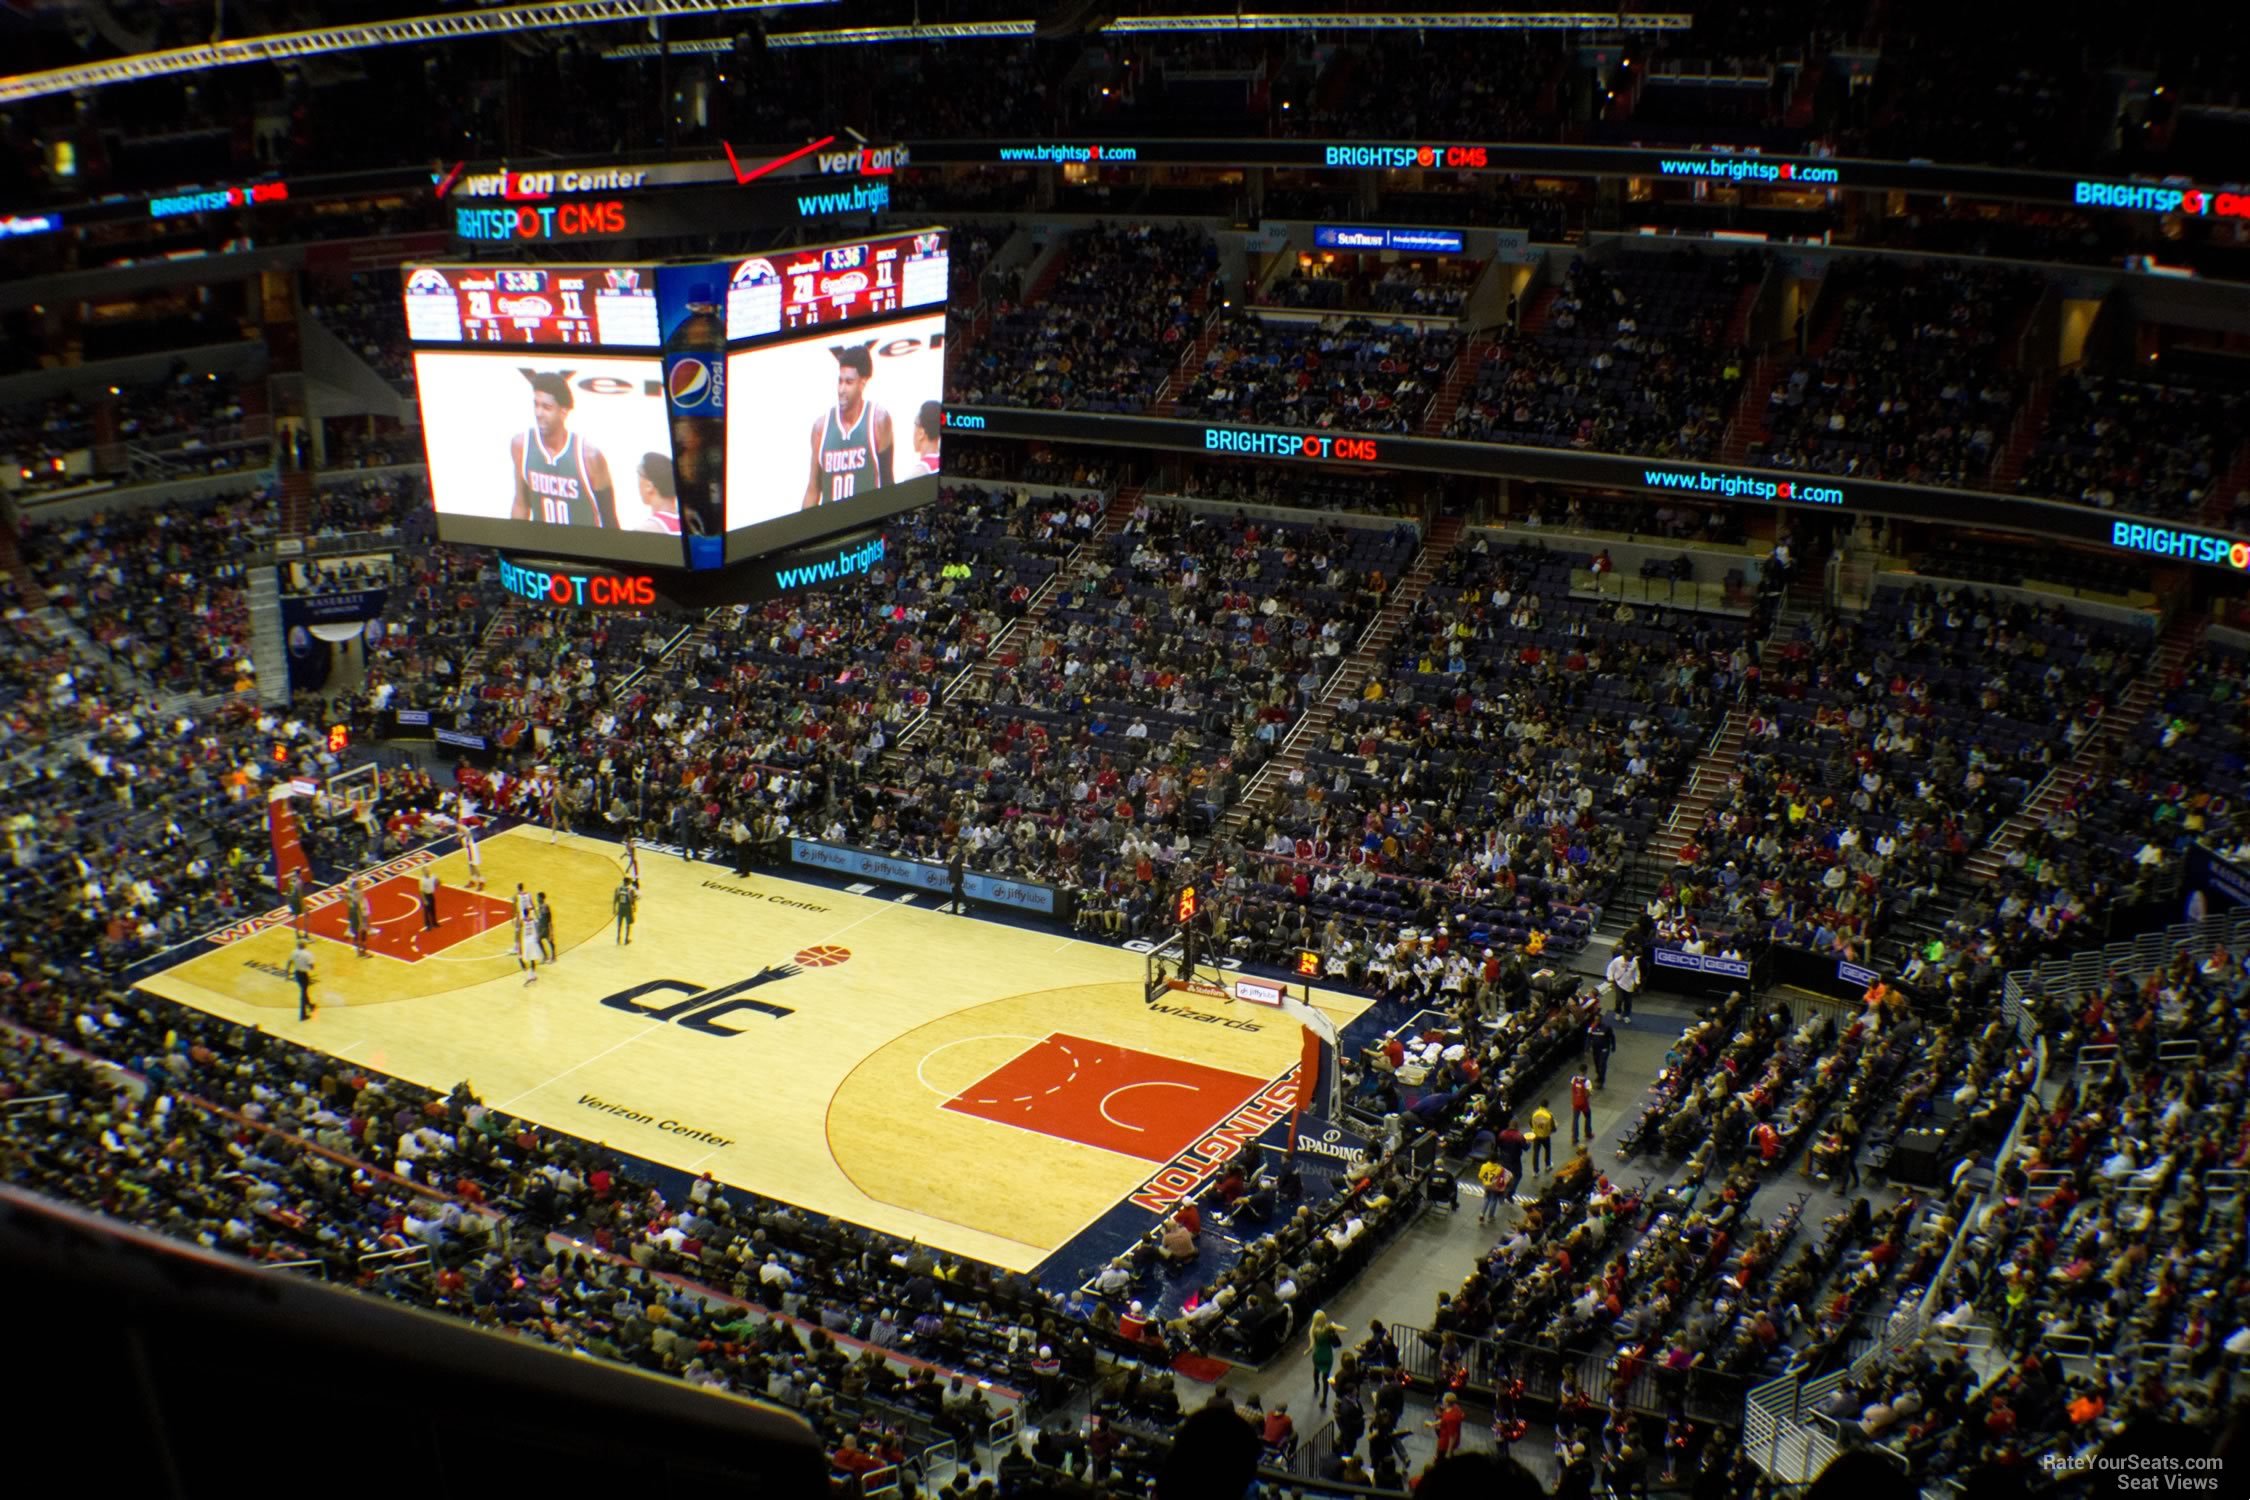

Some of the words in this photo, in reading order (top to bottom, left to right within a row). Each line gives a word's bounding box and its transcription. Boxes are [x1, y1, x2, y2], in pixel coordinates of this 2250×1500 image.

[818, 144, 894, 175] verizon
[1000, 145, 1137, 163] www.brightspot.com
[1326, 146, 1444, 168] BRIGHTSPOT
[1446, 146, 1488, 168] CMS
[467, 168, 554, 200] verizon
[561, 171, 646, 192] Center
[1661, 158, 1839, 184] www.brightspot.com
[151, 187, 254, 217] BRIGHTSPOT
[2075, 181, 2213, 216] BRIGHTSPOT
[558, 201, 626, 235] CMS
[830, 248, 860, 269] 3:36
[825, 446, 866, 473] BUCKS
[1206, 429, 1332, 458] BRIGHTSPOT
[1335, 439, 1377, 461] CMS
[529, 471, 579, 500] BUCKS
[1645, 471, 1843, 504] www.brightspot.com
[2112, 521, 2250, 571] BRIGHTSPO
[590, 575, 656, 605] CMS
[700, 879, 764, 900] Verizon
[767, 895, 832, 914] Center
[1007, 882, 1046, 905] jiffylube
[1179, 898, 1194, 921] 24
[1658, 951, 1700, 966] GEICO
[1705, 958, 1747, 974] GEICO
[1149, 1002, 1264, 1033] wizards
[577, 1094, 654, 1125] Verizon
[657, 1119, 736, 1148] Center
[1297, 1134, 1364, 1163] SPALDING
